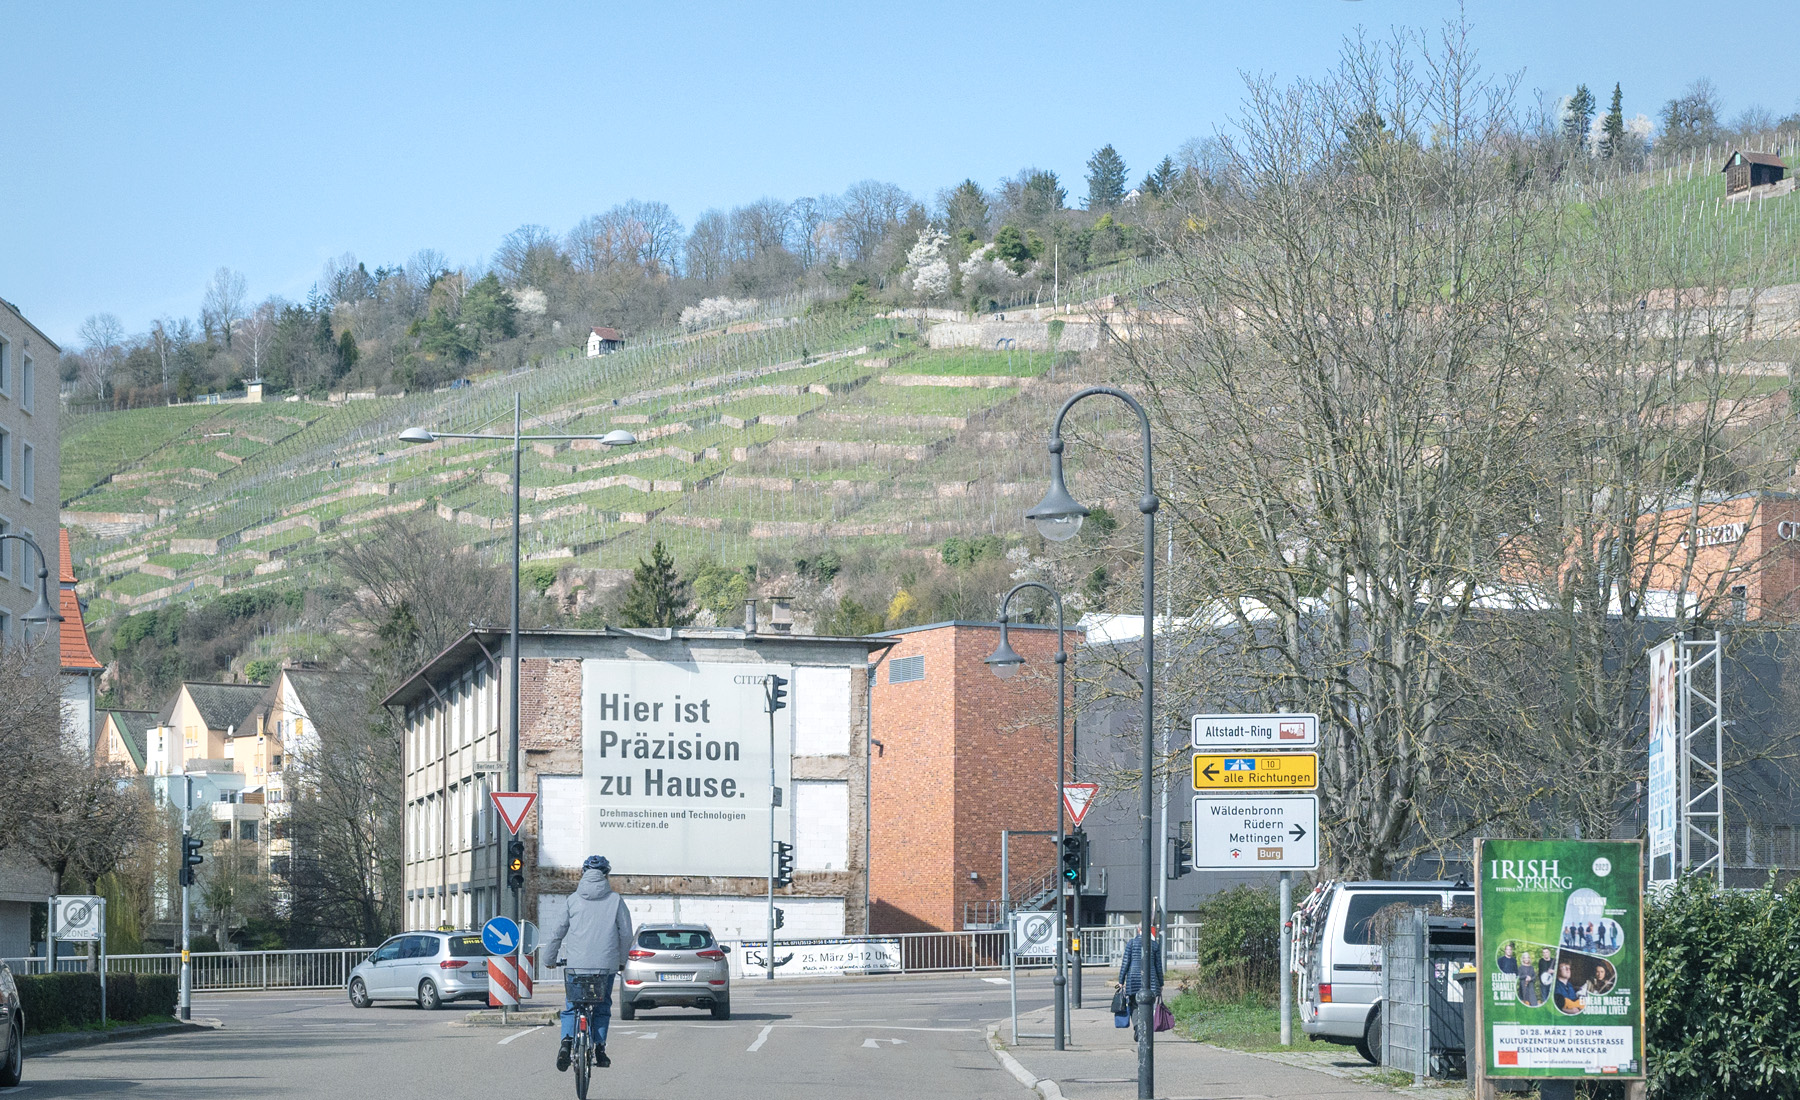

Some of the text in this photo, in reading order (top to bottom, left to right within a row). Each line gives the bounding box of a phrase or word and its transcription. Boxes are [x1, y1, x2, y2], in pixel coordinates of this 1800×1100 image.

[600, 693, 710, 723] Hier ist
[1205, 725, 1272, 739] Altstadt-Ring
[600, 730, 739, 761] Präzision
[1266, 760, 1275, 768] 10
[600, 768, 745, 798] zu Hause.
[1224, 773, 1310, 784] alle Richtungen
[600, 808, 746, 821] Drehmaschinen und Technologien
[1211, 806, 1284, 816] Wäldenbronn
[599, 820, 669, 829] www.citizen.de
[1244, 820, 1284, 829] Rüdern
[1229, 833, 1284, 845] Mettingen
[1259, 850, 1281, 859] Burg
[1491, 859, 1559, 879] IRISH
[1516, 876, 1573, 890] SPRING
[70, 907, 86, 920] 20
[1030, 923, 1046, 936] 20
[1027, 945, 1049, 954] ZONE
[802, 952, 892, 962] 25. März 9-12 Uhr
[1544, 1028, 1567, 1036] MÄRZ
[1517, 1046, 1559, 1054] ESSLINGEN
